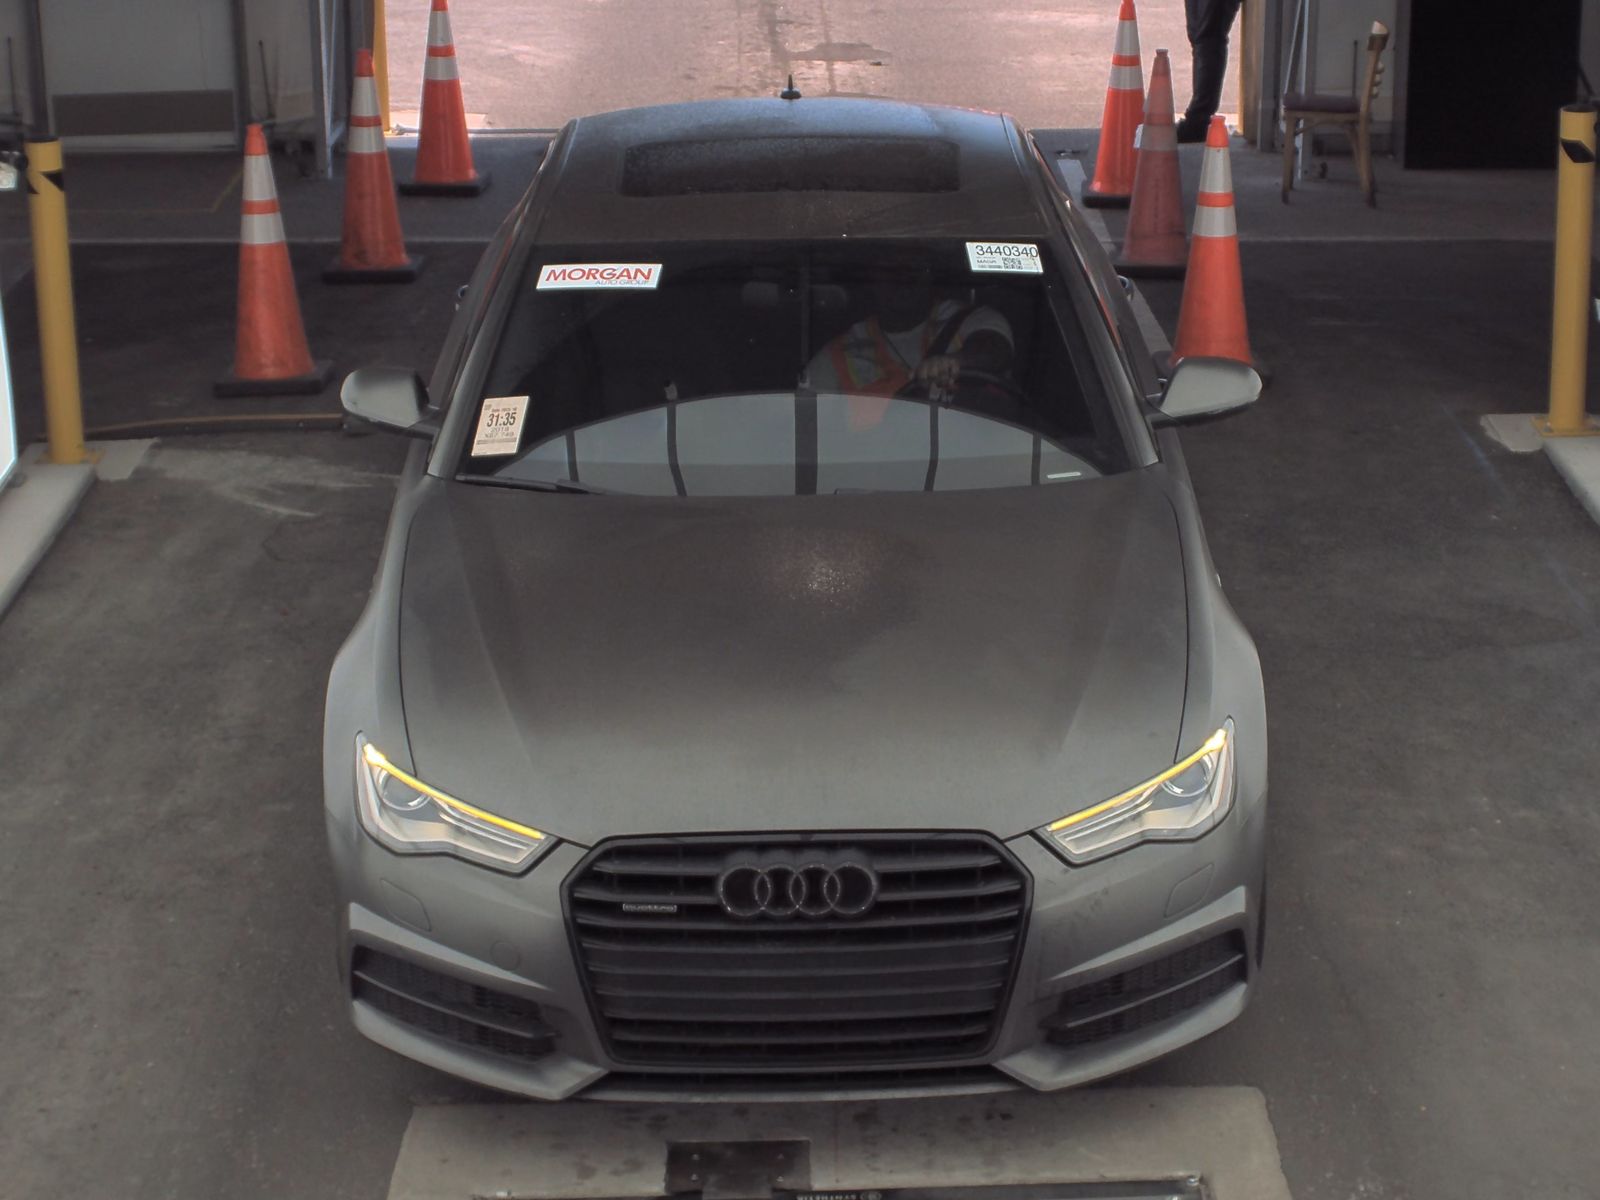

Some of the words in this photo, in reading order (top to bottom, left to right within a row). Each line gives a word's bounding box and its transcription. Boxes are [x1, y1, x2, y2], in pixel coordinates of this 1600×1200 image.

[975, 244, 1038, 258] 3440340
[545, 267, 652, 281] MORGAN
[487, 412, 517, 427] 31:35
